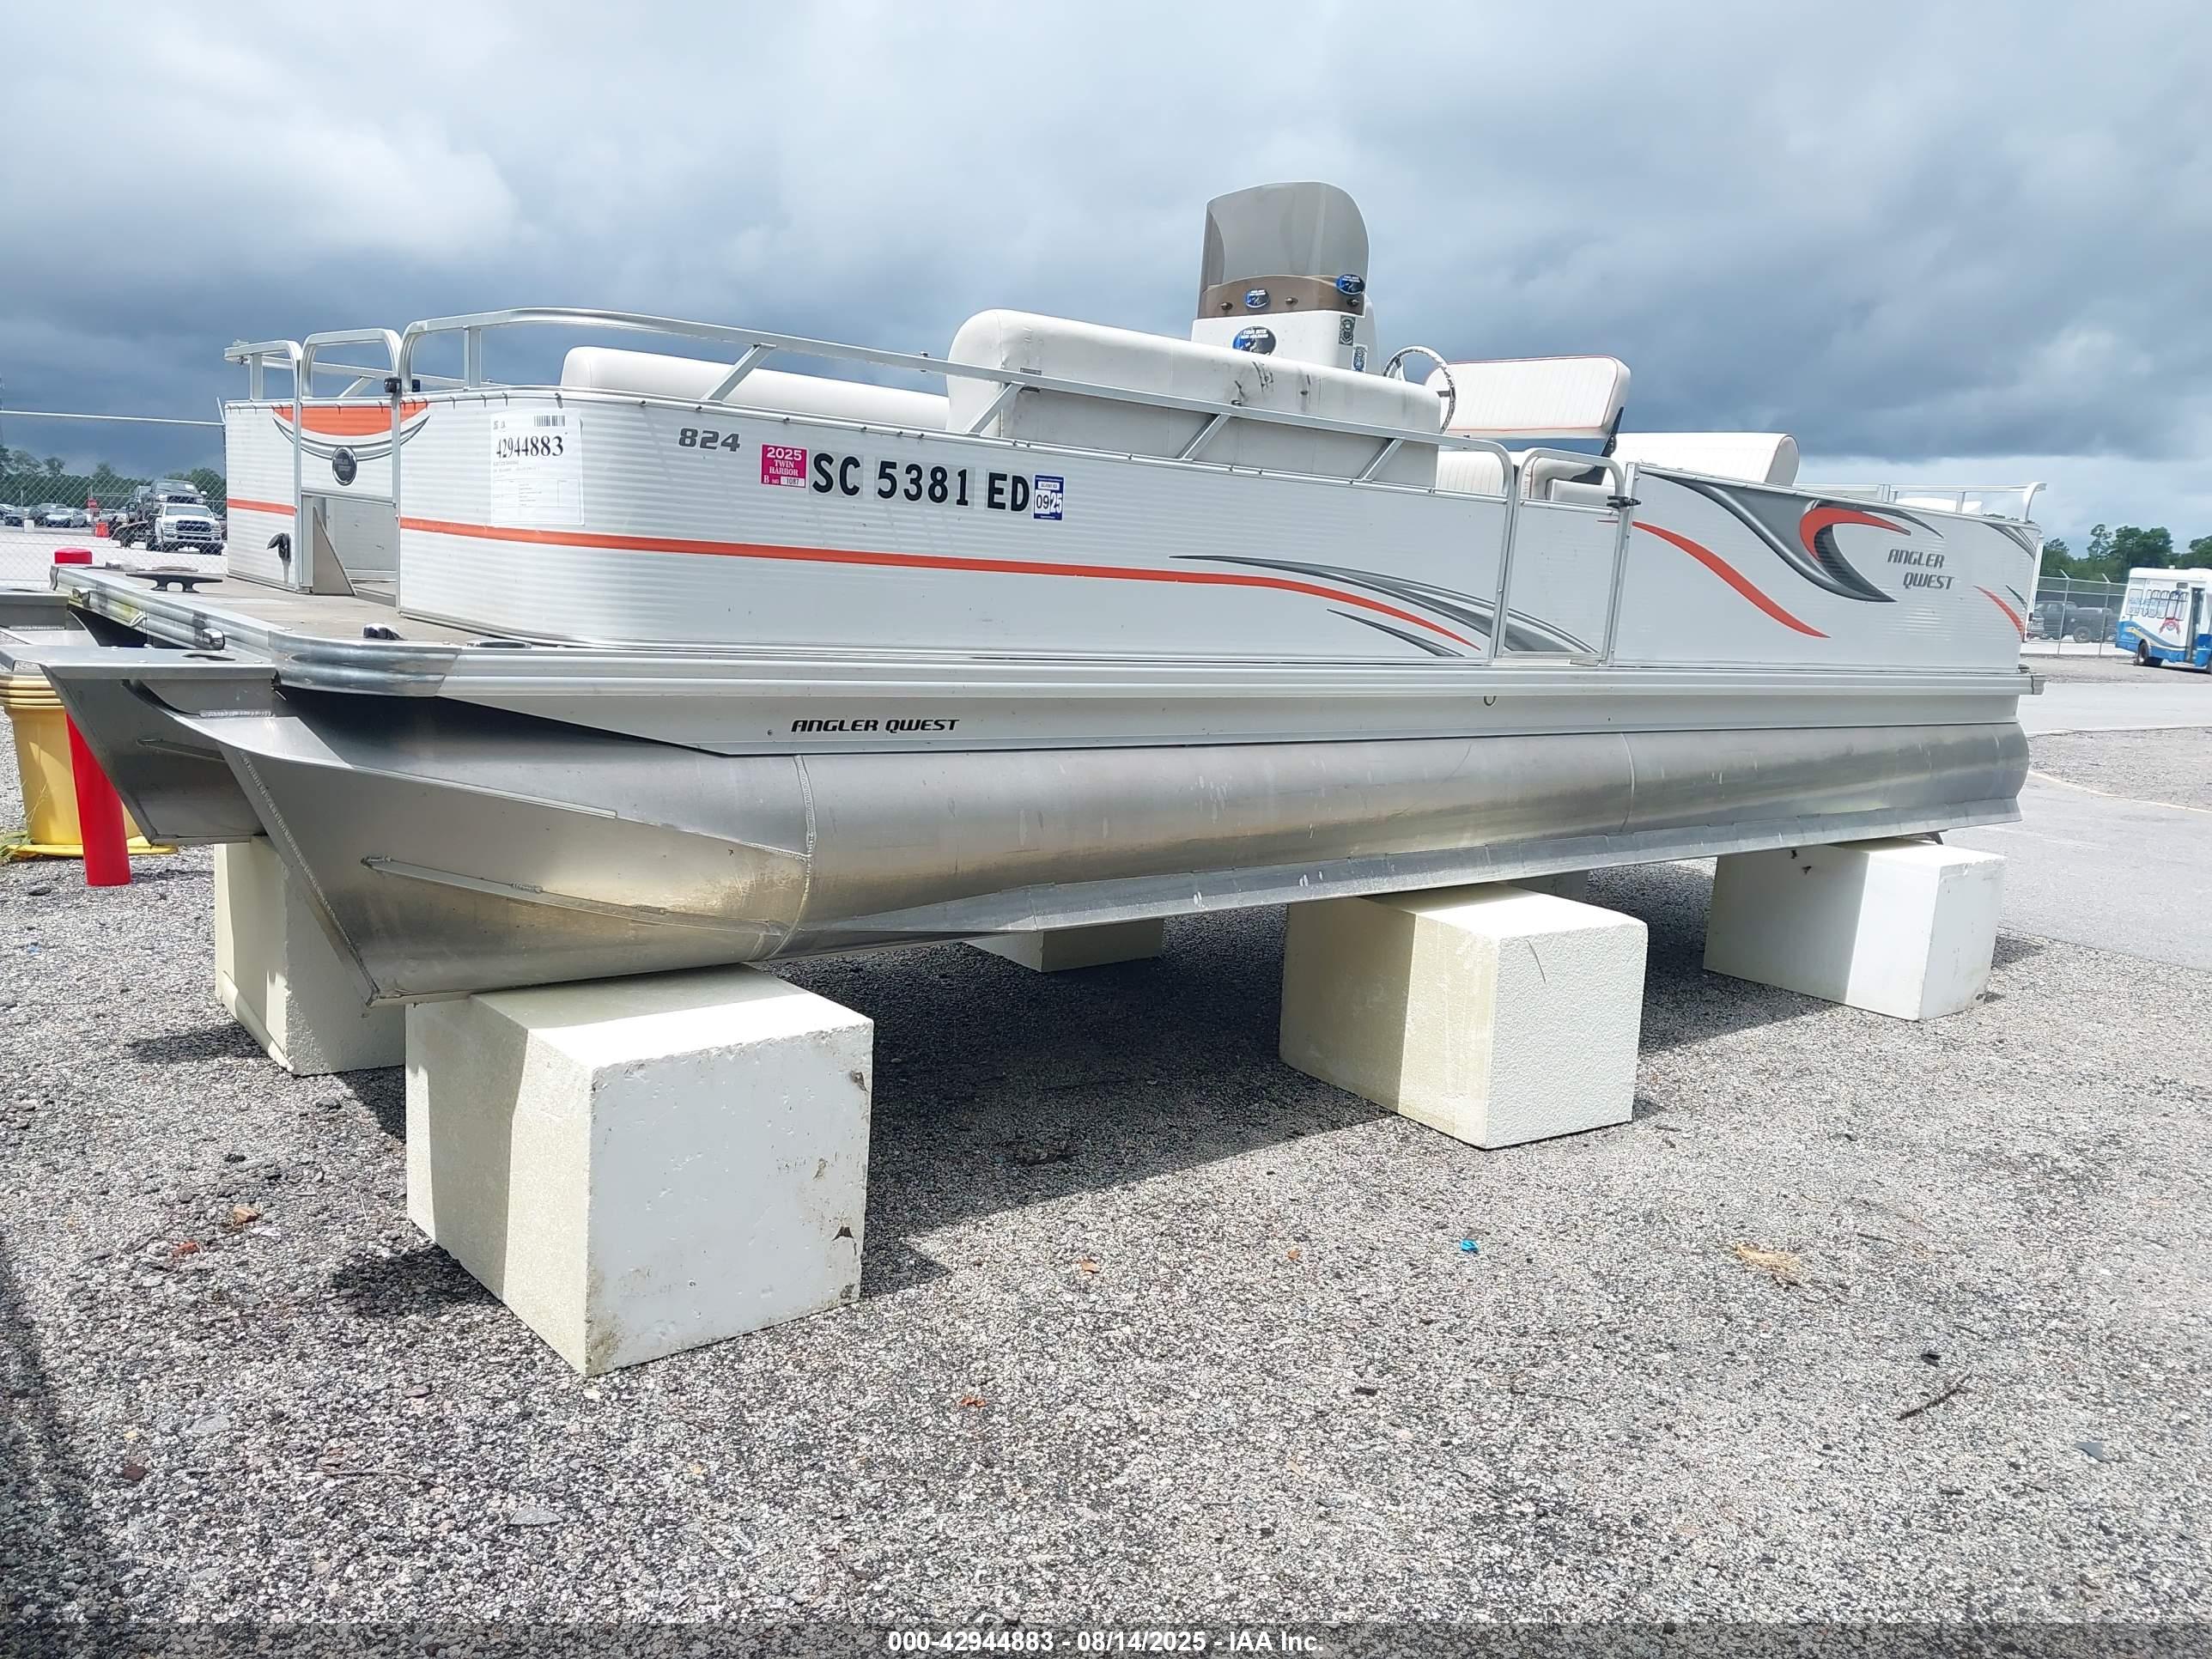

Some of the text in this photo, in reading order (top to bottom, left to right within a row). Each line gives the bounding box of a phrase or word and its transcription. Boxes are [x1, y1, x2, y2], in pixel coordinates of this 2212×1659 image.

[495, 435, 564, 459] 42944883
[678, 428, 740, 452] 824
[767, 447, 802, 461] 2025
[769, 466, 799, 477] HARBOR
[774, 459, 795, 469] TWIN
[812, 452, 1030, 513] SC 5381 ED
[1036, 492, 1062, 514] 09 25
[1887, 549, 1946, 568] ANGLER
[1903, 572, 1955, 591] QWEST
[791, 719, 960, 734] ANGLER QWEST
